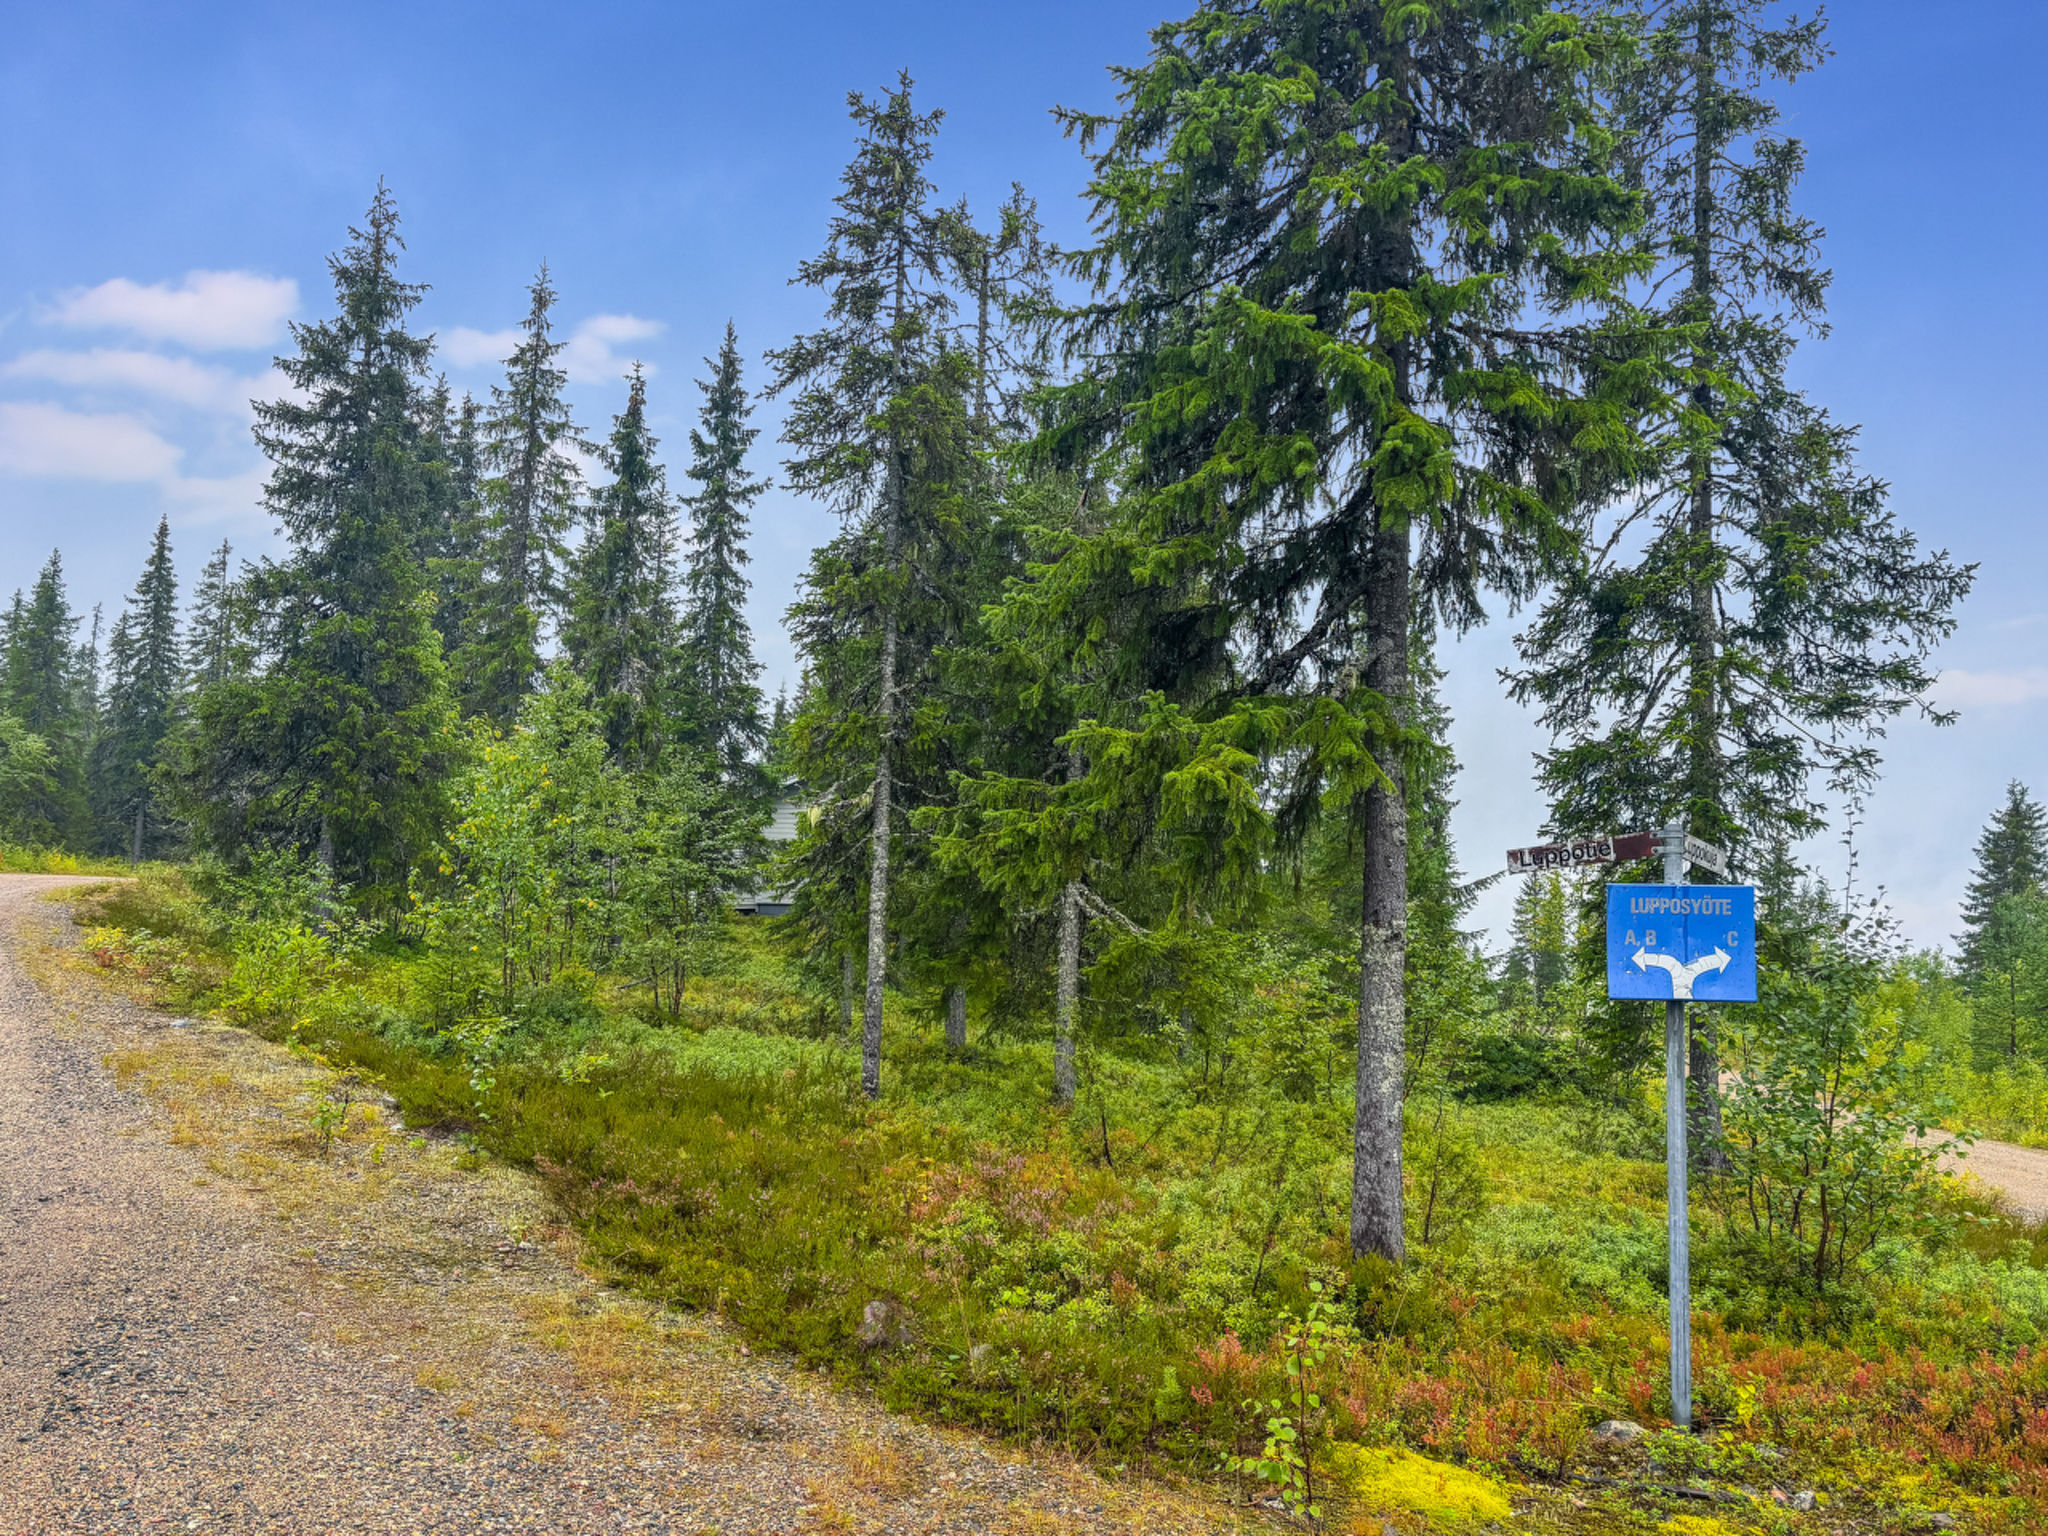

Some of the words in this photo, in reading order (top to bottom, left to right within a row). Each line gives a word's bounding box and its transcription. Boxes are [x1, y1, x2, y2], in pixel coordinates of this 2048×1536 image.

[1518, 839, 1612, 869] Luppotie
[1630, 895, 1733, 916] LUPPOSYÖTE
[1645, 931, 1657, 946] B
[1727, 931, 1739, 947] C
